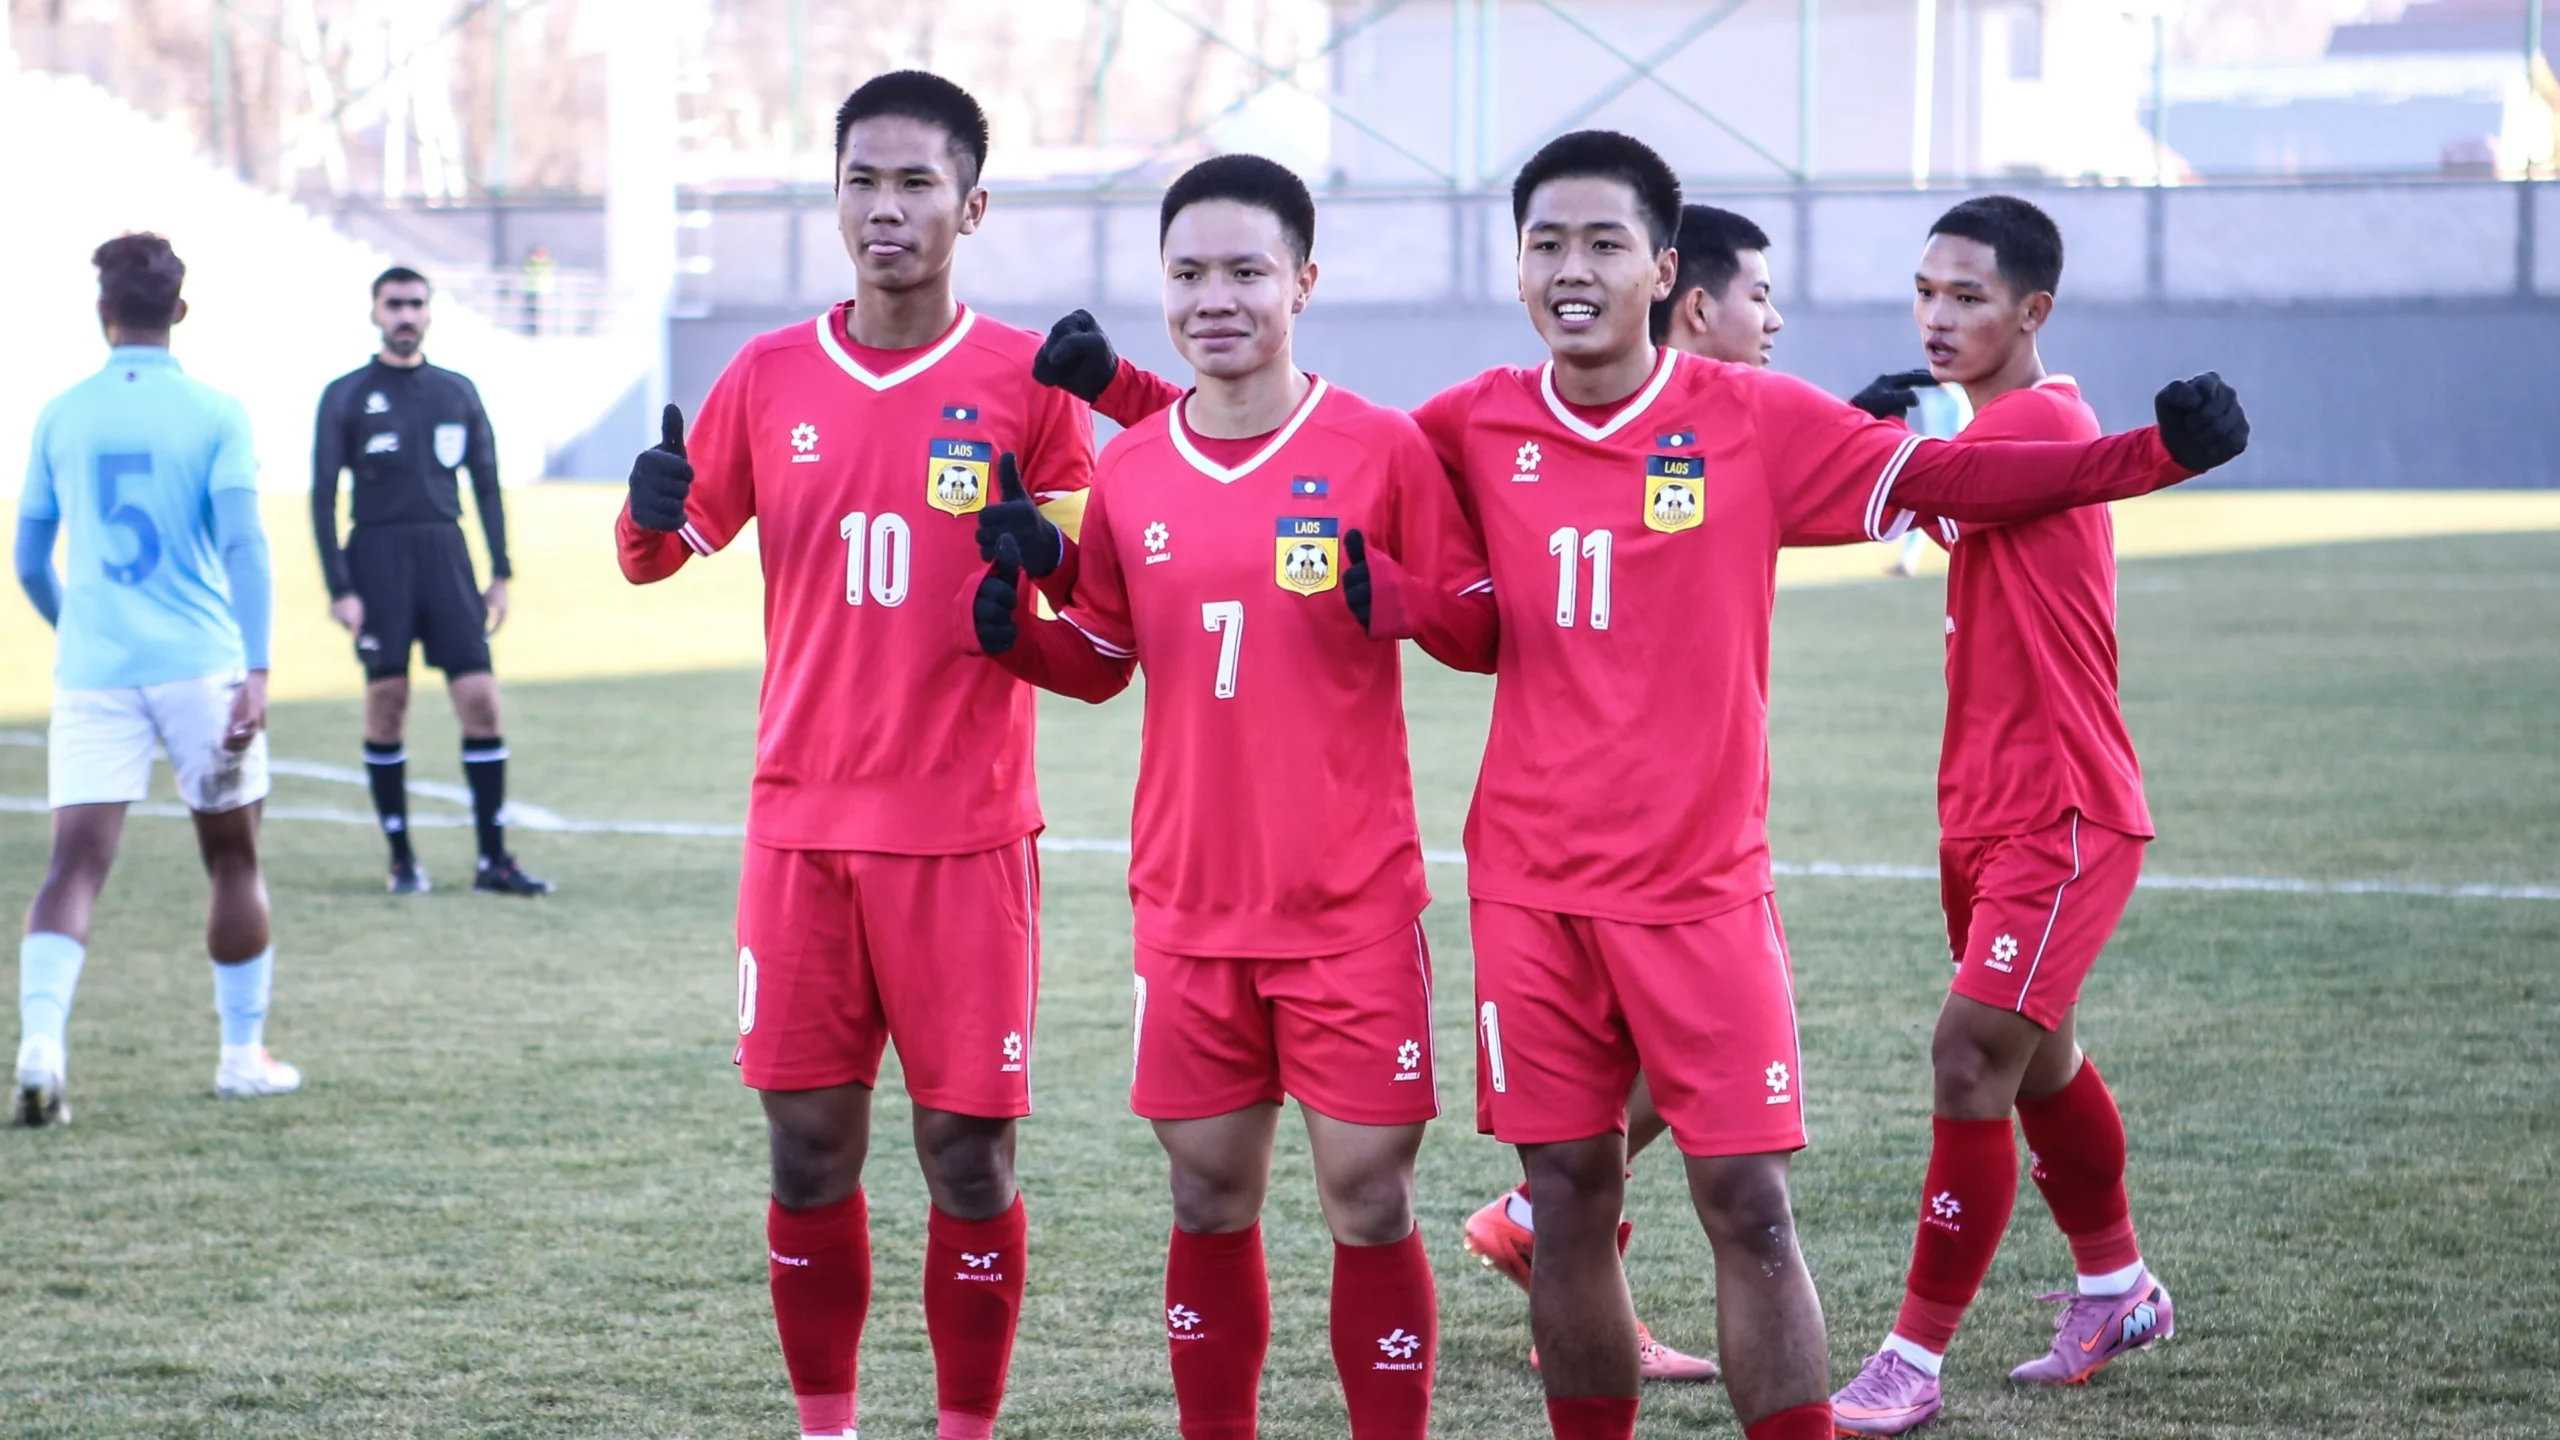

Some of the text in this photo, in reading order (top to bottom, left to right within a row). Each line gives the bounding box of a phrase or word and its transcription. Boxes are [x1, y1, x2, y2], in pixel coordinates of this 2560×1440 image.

[948, 443, 973, 457] LAOS
[1664, 461, 1689, 475] LAOS
[97, 452, 160, 585] 5
[840, 511, 910, 608] 10
[1294, 521, 1320, 534] LAOS
[1549, 526, 1613, 630] 11
[1201, 600, 1244, 699] 7
[1480, 1001, 1506, 1093] 1
